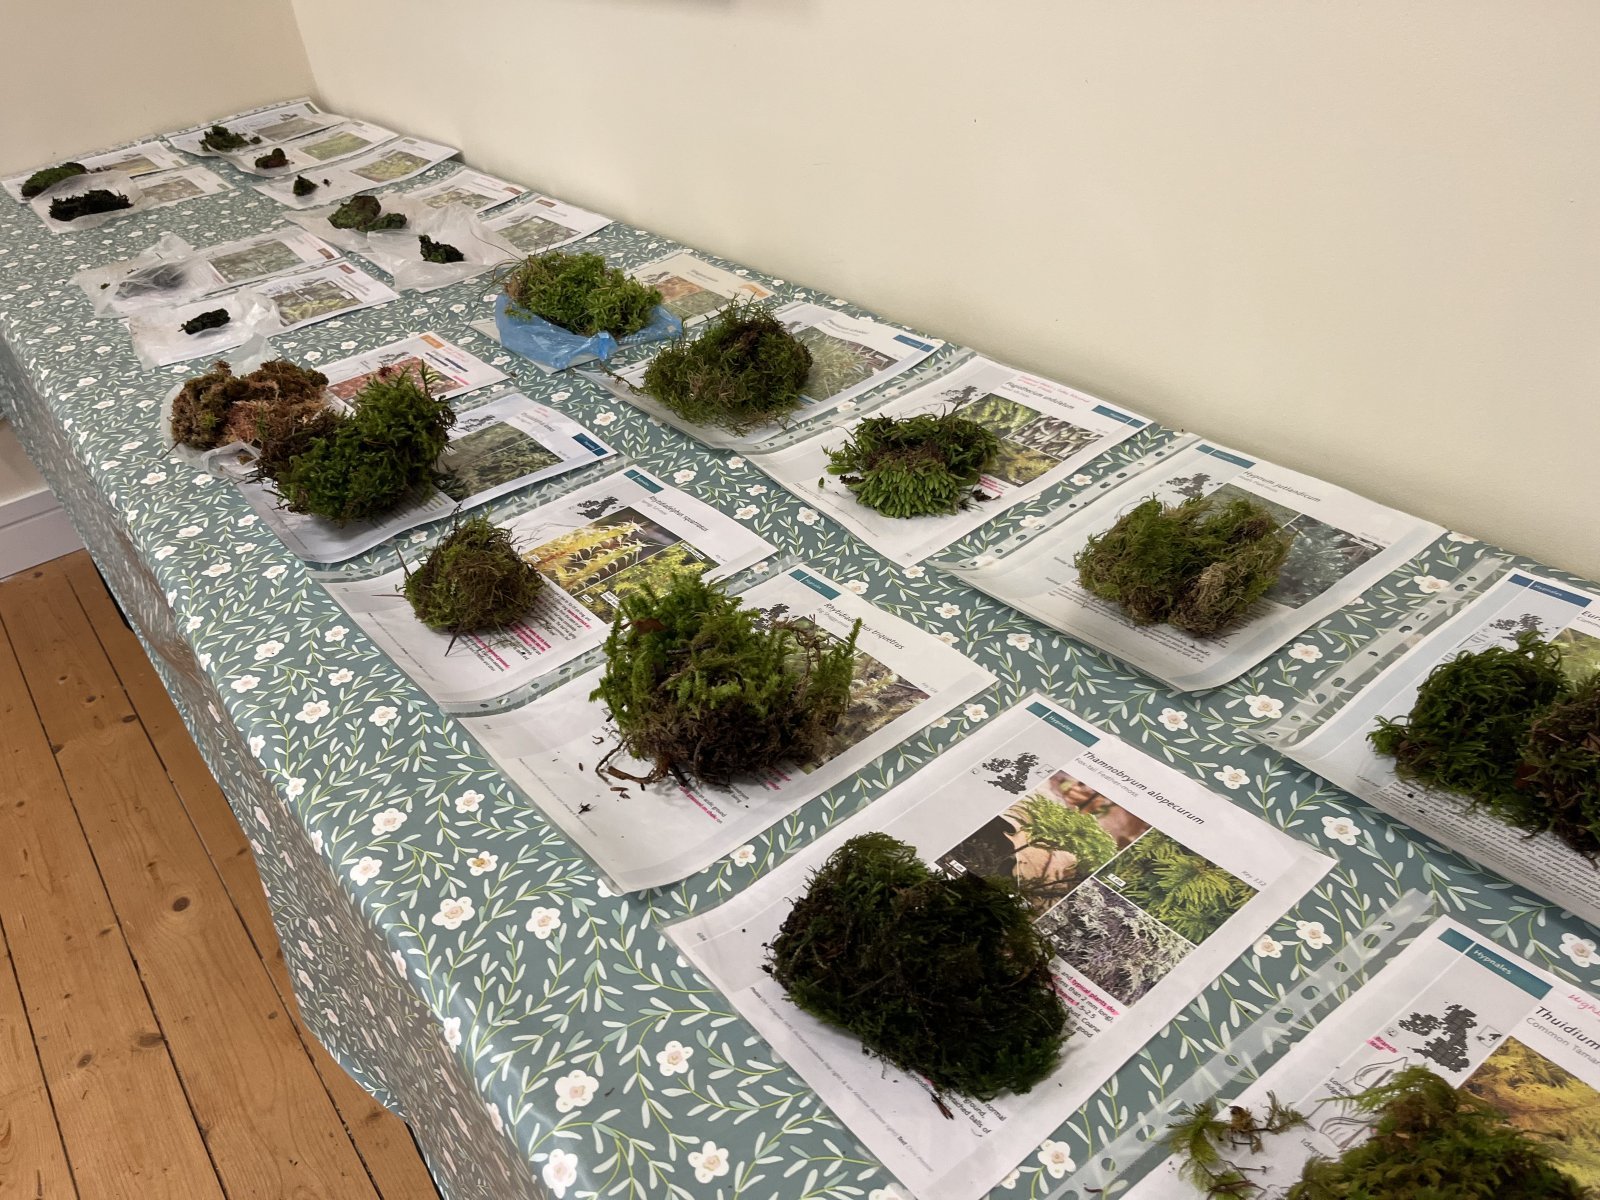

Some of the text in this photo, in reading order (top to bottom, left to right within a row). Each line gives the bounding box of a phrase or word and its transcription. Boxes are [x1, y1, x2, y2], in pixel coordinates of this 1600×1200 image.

[1083, 751, 1204, 825] Thamnobryum alopecurum
[1473, 949, 1512, 976] Hypnales
[1068, 986, 1082, 998] than
[1072, 980, 1092, 994] typical
[1088, 993, 1107, 1007] plants
[1526, 1017, 1570, 1046] Common
[969, 1114, 984, 1128] balls
[984, 1103, 1007, 1122] normal
